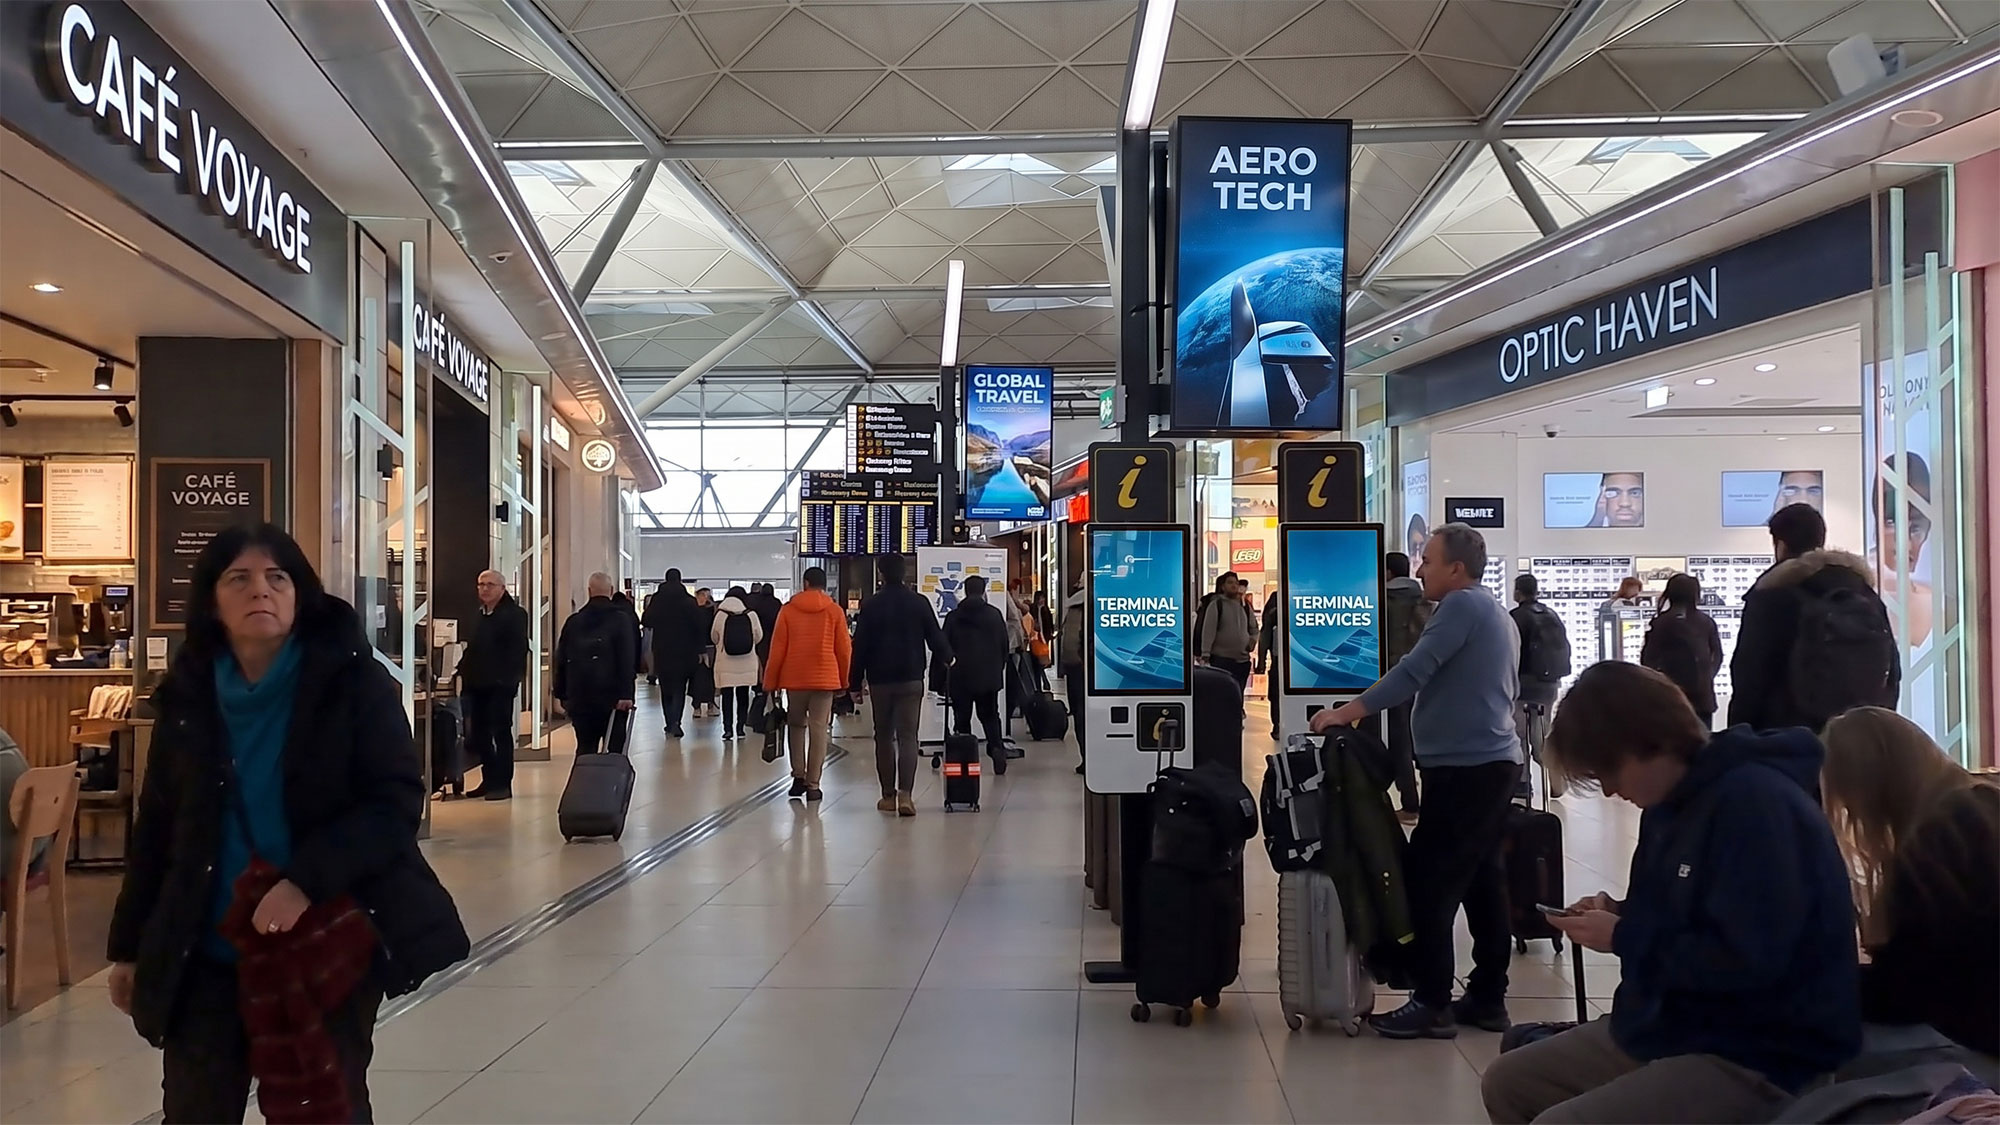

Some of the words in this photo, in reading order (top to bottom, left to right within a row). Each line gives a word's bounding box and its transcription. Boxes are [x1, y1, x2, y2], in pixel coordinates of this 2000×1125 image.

[60, 3, 182, 175] CAFÉ
[190, 108, 311, 274] VOYAGE
[1209, 145, 1318, 176] AERO
[1213, 181, 1312, 211] TECH
[1498, 314, 1584, 384] OPTIC
[1594, 266, 1718, 355] HAVEN
[413, 303, 446, 369] CAFÉ
[447, 331, 488, 402] VOYAGE
[973, 373, 1046, 389] GLOBAL
[975, 389, 1044, 404] TRAVEL
[185, 471, 237, 489] CAFÉ
[171, 491, 250, 505] VOYAGE
[1232, 549, 1261, 562] LEGO
[1098, 597, 1179, 611] TERMINAL
[1293, 596, 1374, 610] TERMINAL
[1100, 613, 1176, 628] SERVICES
[1295, 612, 1372, 627] SERVICES
